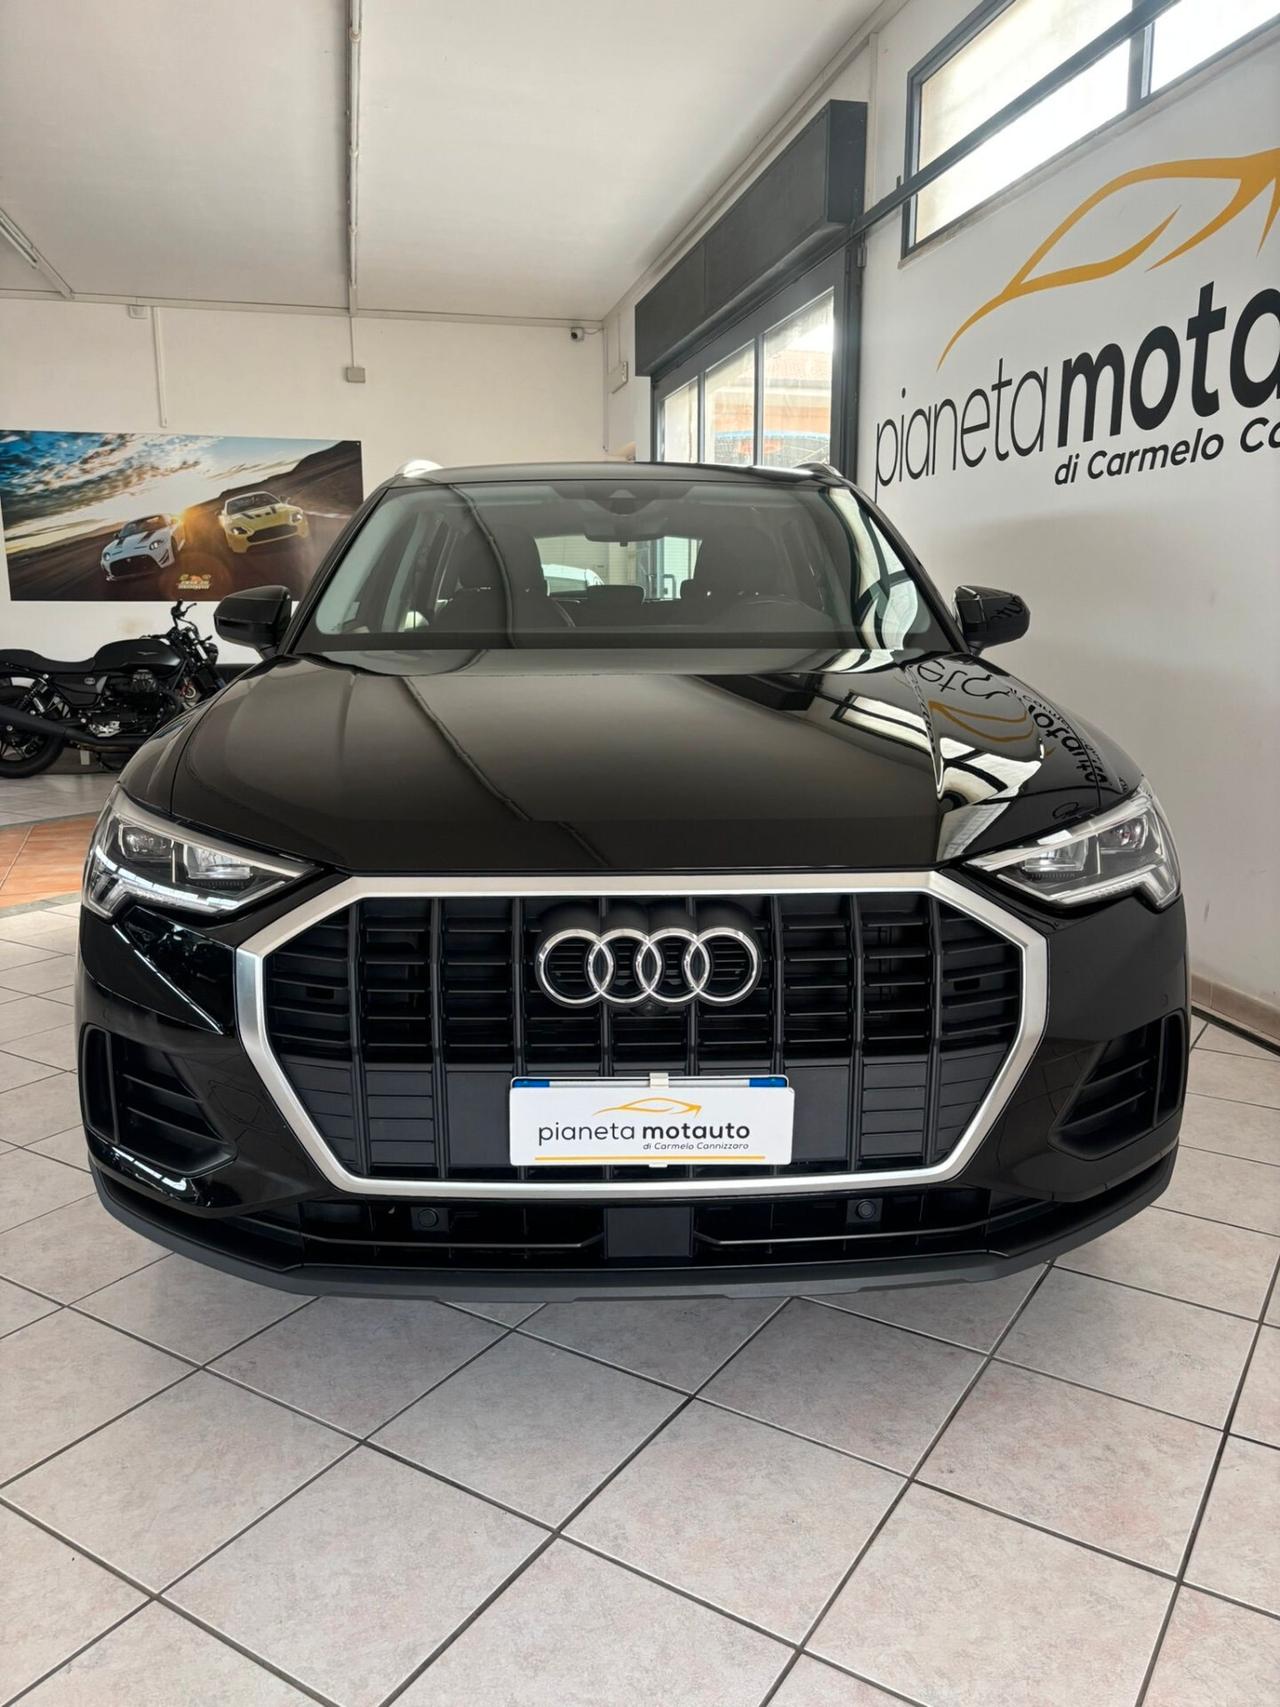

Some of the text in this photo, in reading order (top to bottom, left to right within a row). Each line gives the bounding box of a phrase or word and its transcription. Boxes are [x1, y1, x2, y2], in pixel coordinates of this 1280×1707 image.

[875, 281, 1280, 504] pianeta mota
[1054, 453, 1080, 485] di
[1087, 428, 1224, 480] Carmelo
[538, 1122, 750, 1146] pianeta motauto
[654, 1142, 694, 1150] Carmelo
[697, 1142, 749, 1150] Cannizzaro
